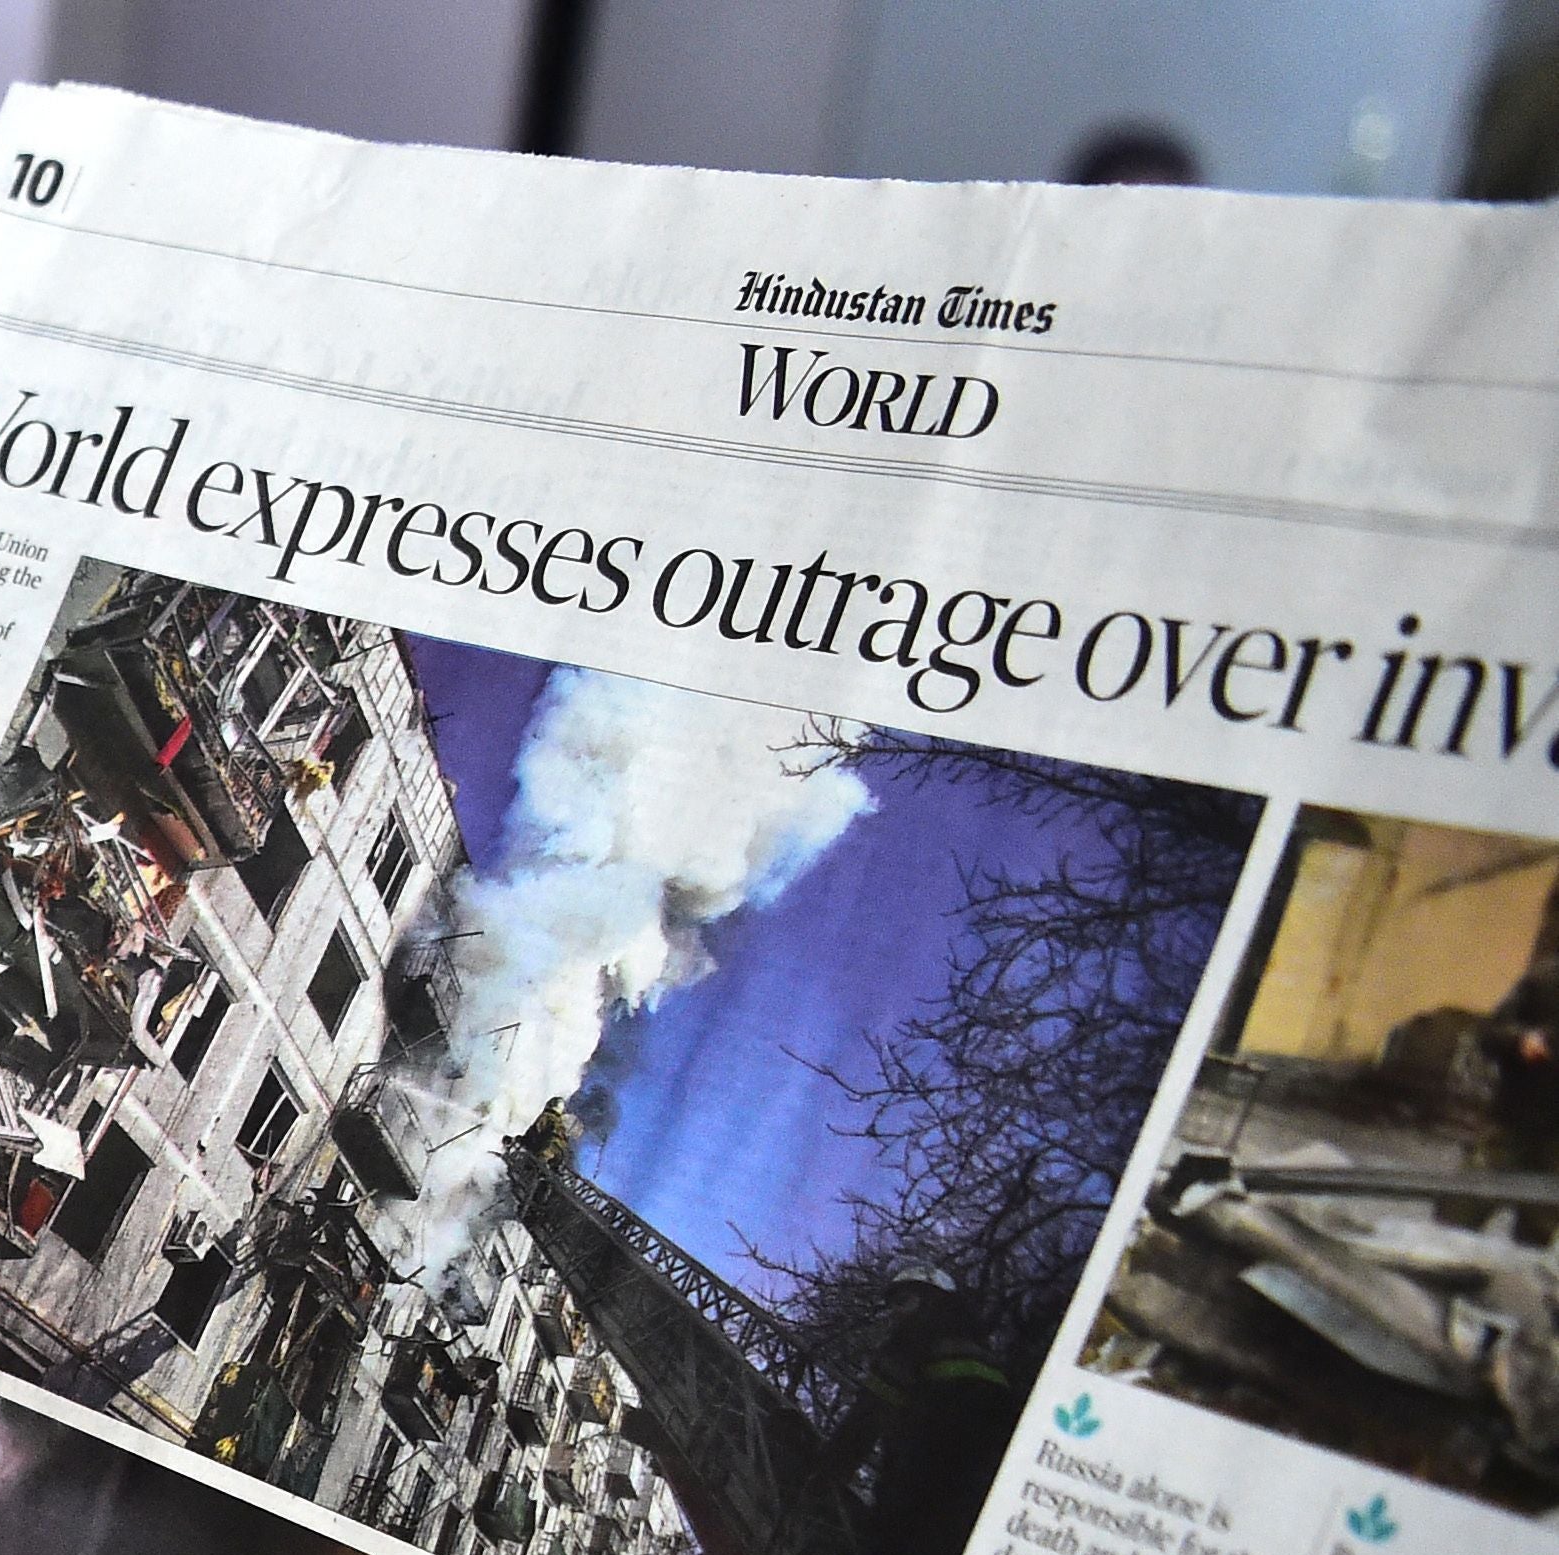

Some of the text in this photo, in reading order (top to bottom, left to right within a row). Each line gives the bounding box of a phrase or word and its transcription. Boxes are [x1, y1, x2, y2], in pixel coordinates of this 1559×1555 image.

[7, 152, 64, 206] 10
[736, 270, 1058, 335] Hindustan Times
[737, 342, 1000, 439] WORLD
[12, 565, 43, 590] the
[186, 461, 645, 614] expresses
[652, 548, 1063, 713] outrage
[1074, 611, 1355, 731] over
[1350, 611, 1559, 772] inv
